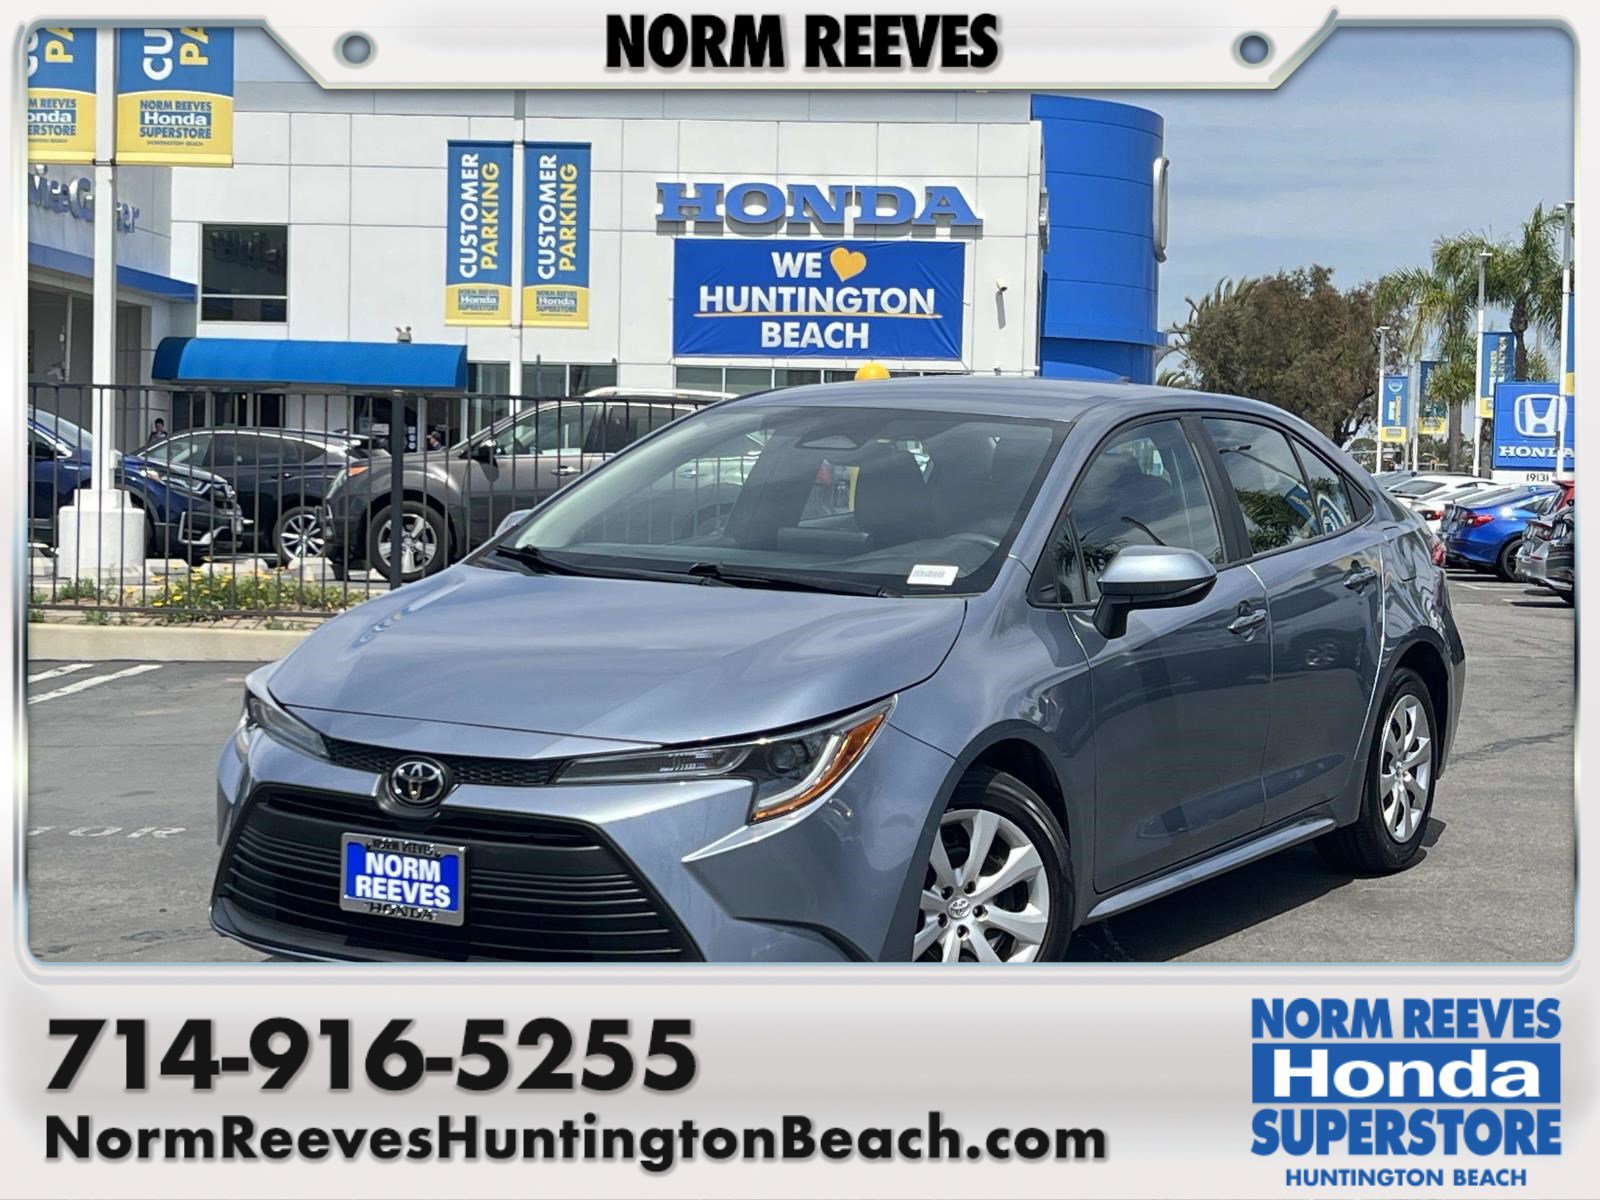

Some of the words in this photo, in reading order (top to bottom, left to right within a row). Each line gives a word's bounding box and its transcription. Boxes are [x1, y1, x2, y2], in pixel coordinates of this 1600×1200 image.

[40, 98, 76, 109] REEVES
[140, 100, 172, 111] NORM
[175, 101, 212, 111] REEVES
[139, 127, 212, 139] SUPERSTORE
[144, 112, 208, 126] Honda
[459, 153, 479, 279] CUSTOMER
[480, 162, 500, 270] PARKING
[538, 154, 557, 280] CUSTOMER
[559, 163, 578, 271] PARKING
[656, 182, 983, 227] HONDA
[771, 252, 822, 279] WE
[699, 286, 936, 315] HUNTINGTON
[761, 322, 870, 349] BEACH
[1526, 472, 1549, 483] 19131
[365, 852, 441, 883] NORM
[355, 874, 451, 908] REEVES
